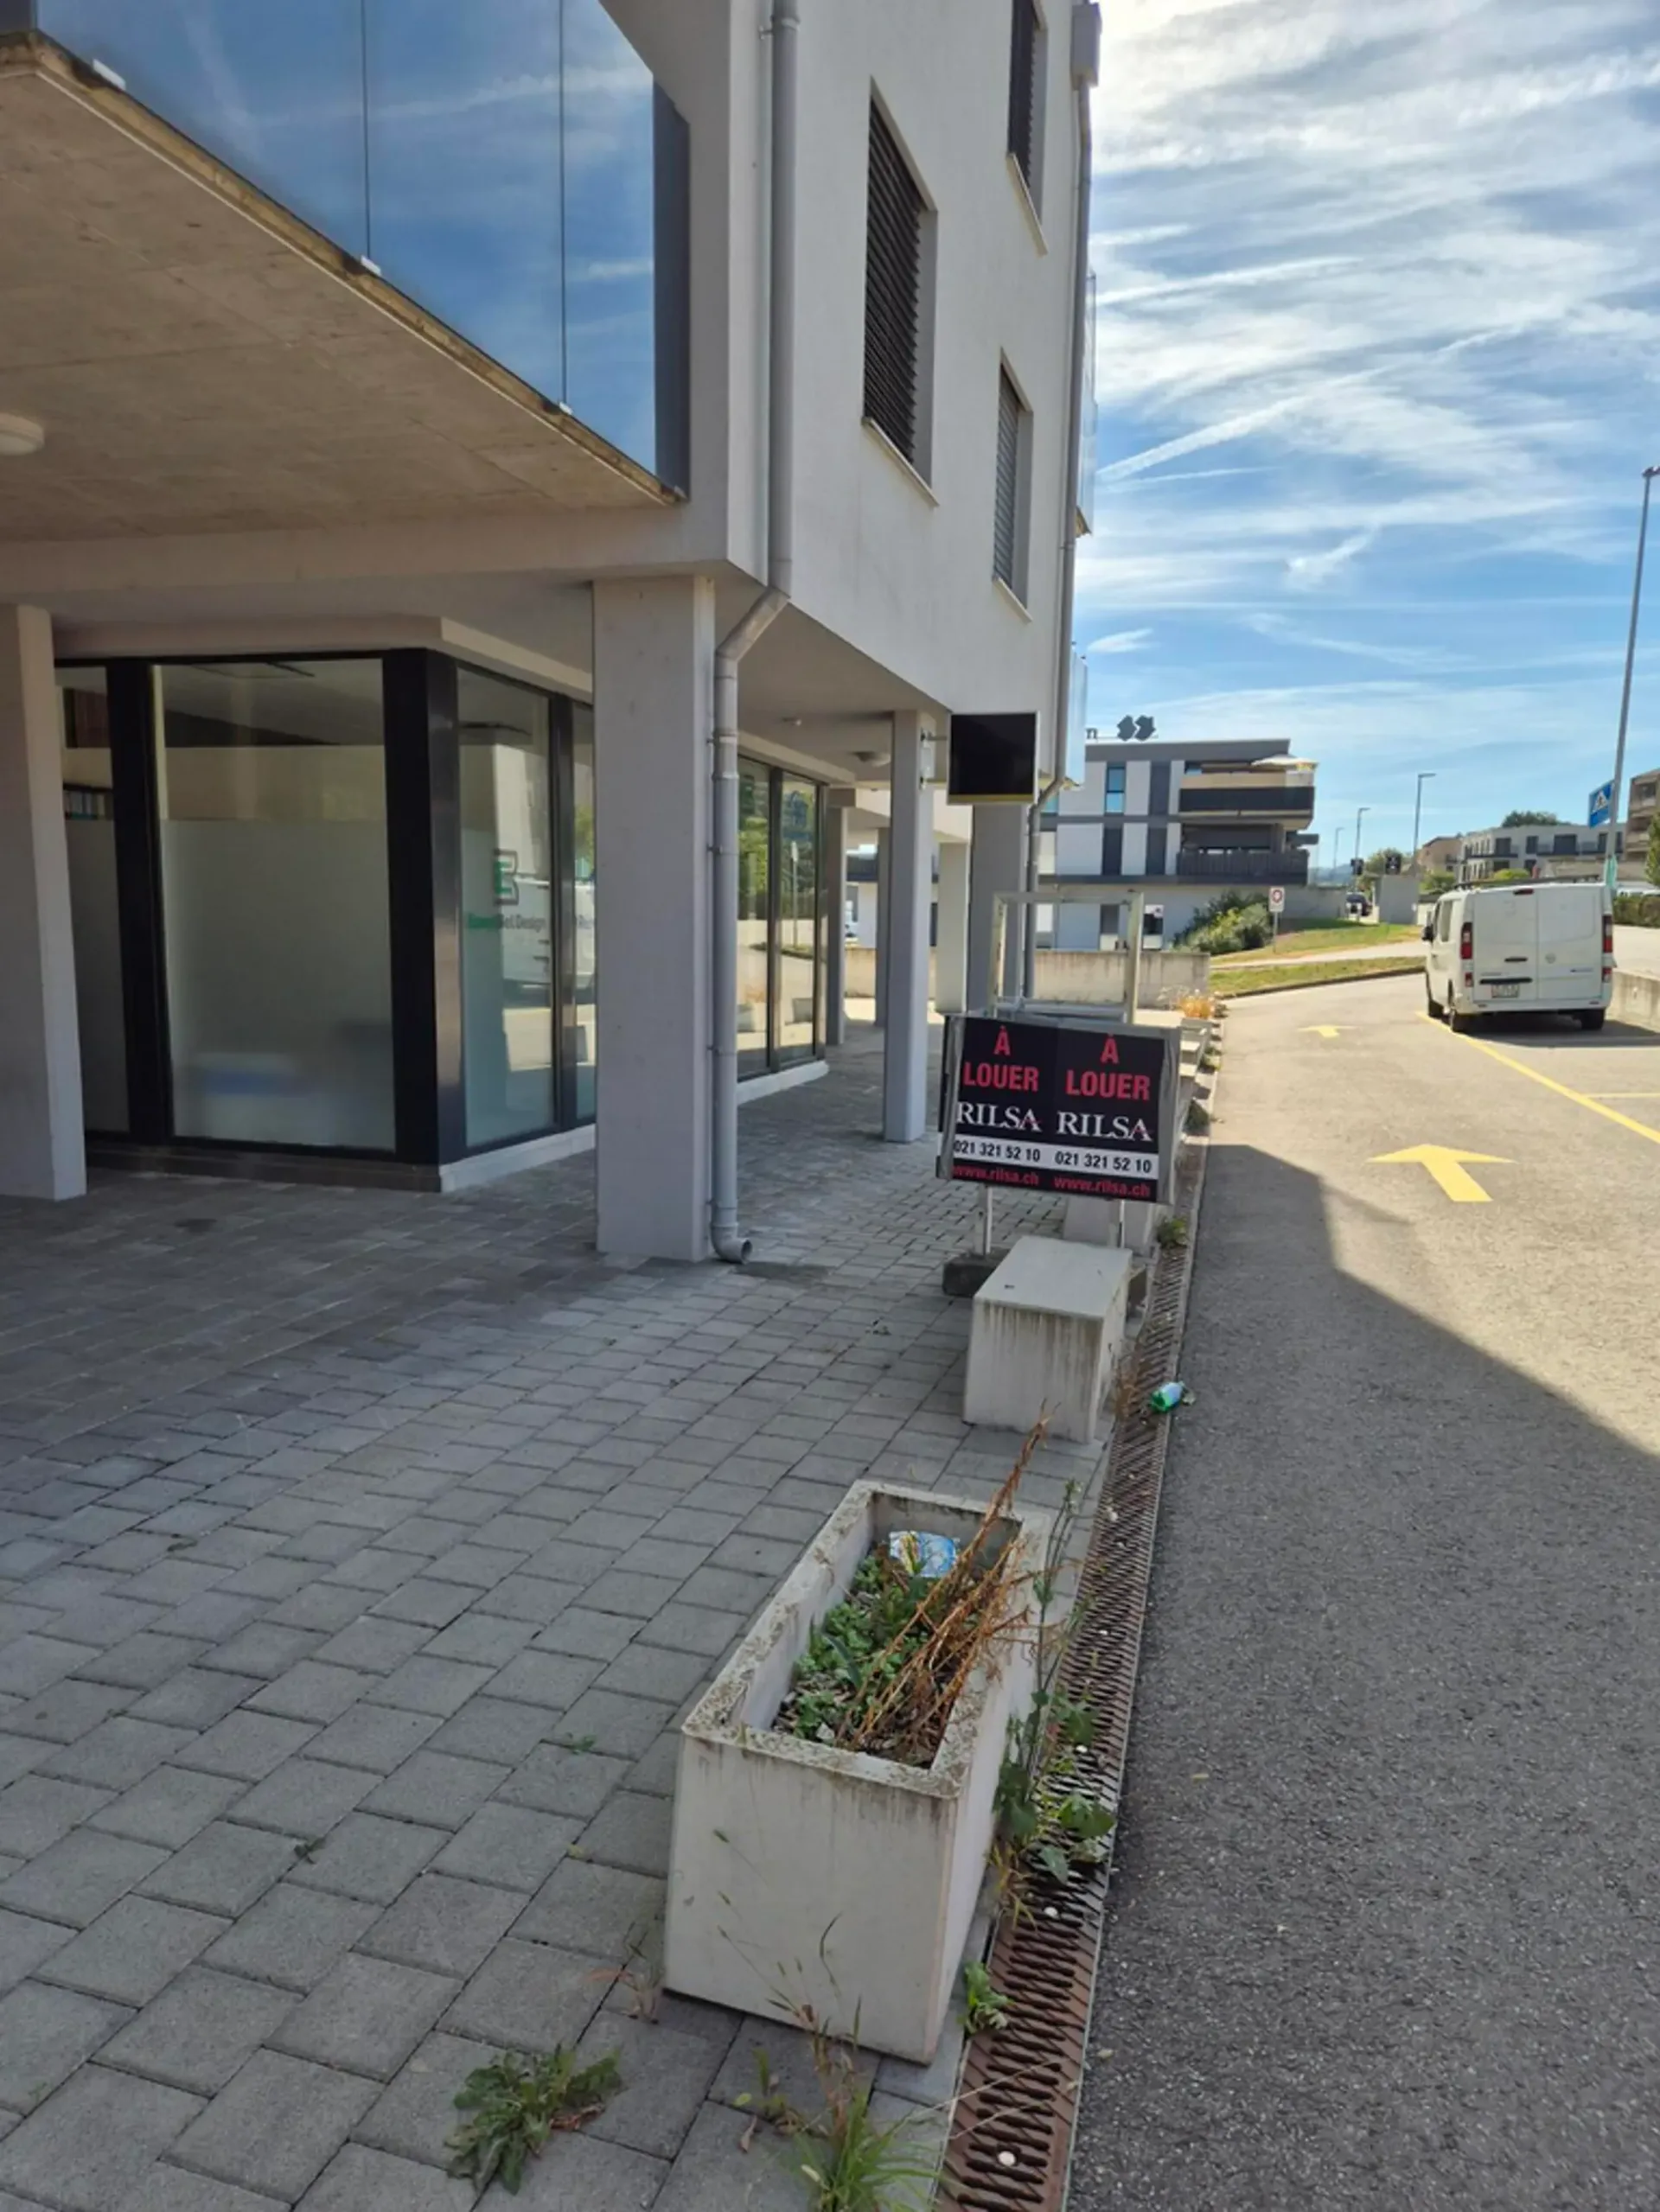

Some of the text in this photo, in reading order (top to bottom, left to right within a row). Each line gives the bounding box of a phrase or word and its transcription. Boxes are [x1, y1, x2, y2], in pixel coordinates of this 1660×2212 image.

[962, 1061, 1039, 1092] LOUER
[1064, 1068, 1151, 1100] LOUER
[956, 1100, 1043, 1132] RILSA
[1057, 1110, 1153, 1142] RILSA
[954, 1139, 1041, 1162] 021 321 52 10
[1055, 1151, 1152, 1173] 021 321 52 10
[1053, 1176, 1151, 1197] www.rilsa.ch
